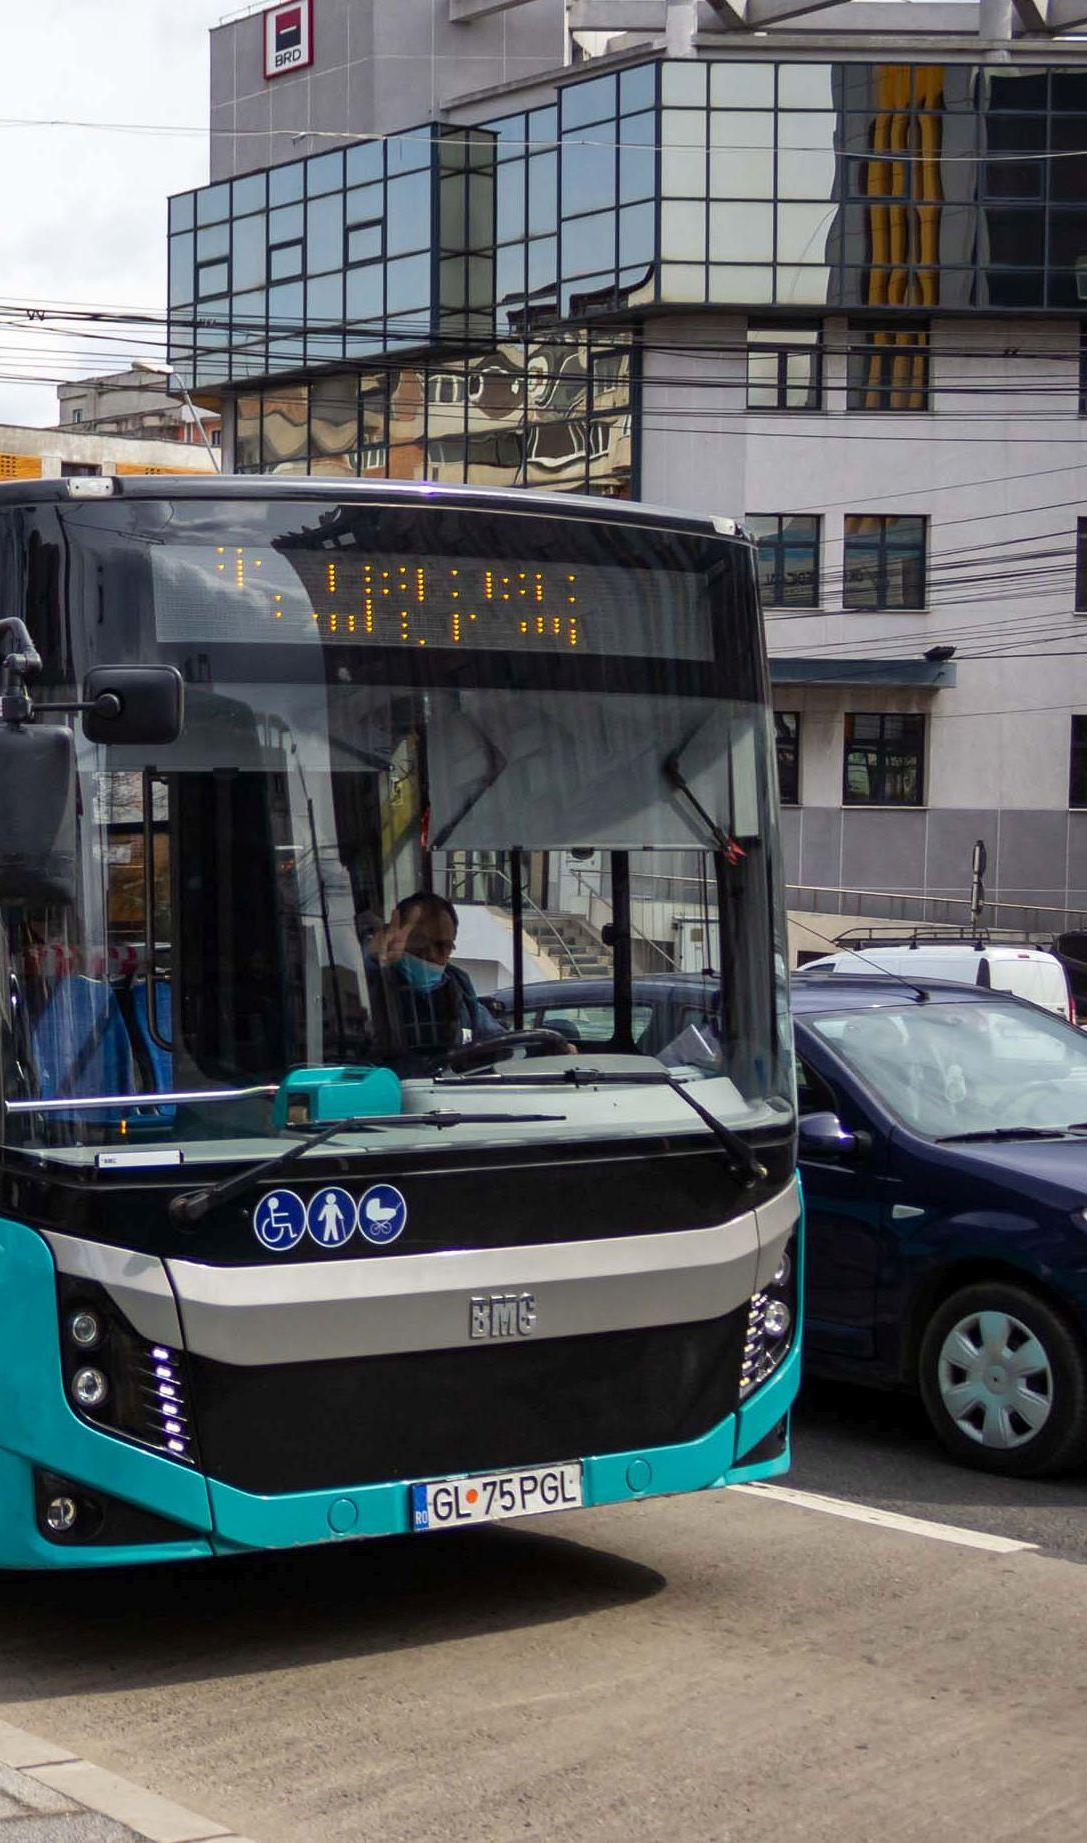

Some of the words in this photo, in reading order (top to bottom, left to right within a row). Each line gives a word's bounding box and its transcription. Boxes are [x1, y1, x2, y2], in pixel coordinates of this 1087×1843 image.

[275, 49, 302, 67] BRD
[470, 1292, 537, 1339] BMC
[432, 1486, 471, 1521] GL
[415, 1510, 428, 1525] RO
